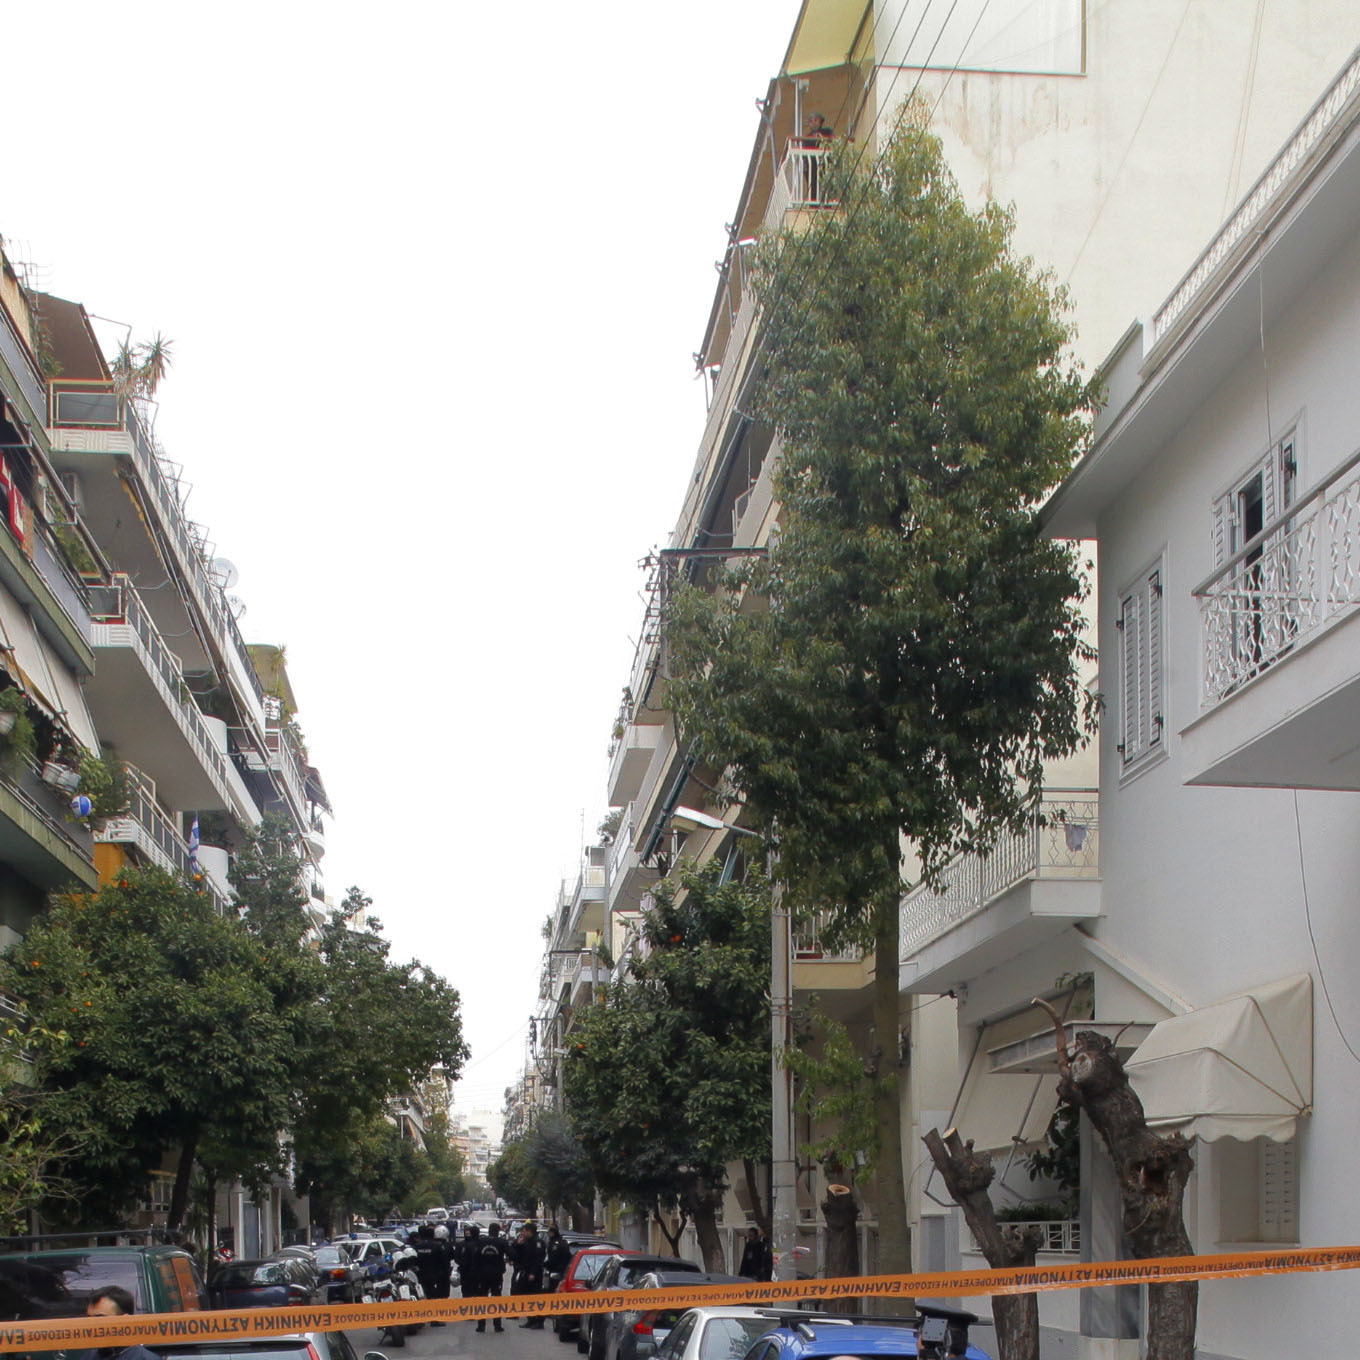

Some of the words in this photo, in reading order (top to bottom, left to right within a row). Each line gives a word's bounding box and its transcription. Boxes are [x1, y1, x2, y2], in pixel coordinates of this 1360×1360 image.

[1265, 1253, 1333, 1268] ΑΣΤΥΝΟΜΙΑ
[1015, 1269, 1091, 1286] ΑΣΤΥΝΟΜΙΑ
[1095, 1265, 1161, 1281] ΕΛΛΗΝΙΚΗ
[830, 1281, 901, 1296] ΕΛΛΗΝΙΚΗ
[902, 1281, 941, 1291] ΕΙΣΟΔΟΣ
[949, 1276, 1016, 1289] ΑΠΑΓΟΡΕΥΕΤΑΙ
[745, 1284, 827, 1299] ΑΣΤΥΝΟΜΙΑ
[458, 1300, 546, 1317] ΑΣΤΥΝΟΜΙΑ
[549, 1296, 624, 1312] ΕΛΛΗΝΙΚΗ
[334, 1313, 376, 1325] ΕΙΣΟΔΟΣ
[386, 1307, 458, 1321] ΑΠΑΓΟΡΕΥΕΤΑΙ
[158, 1316, 249, 1336] ΑΣΤΥΝΟΜΙΑ
[254, 1313, 332, 1331] ΕΛΛΗΝΙΚΗ
[27, 1329, 72, 1342] ΕΙΣΟΔΟΣ
[83, 1325, 159, 1339] ΑΠΑΓΟΡΕΥΕΤΑΙ
